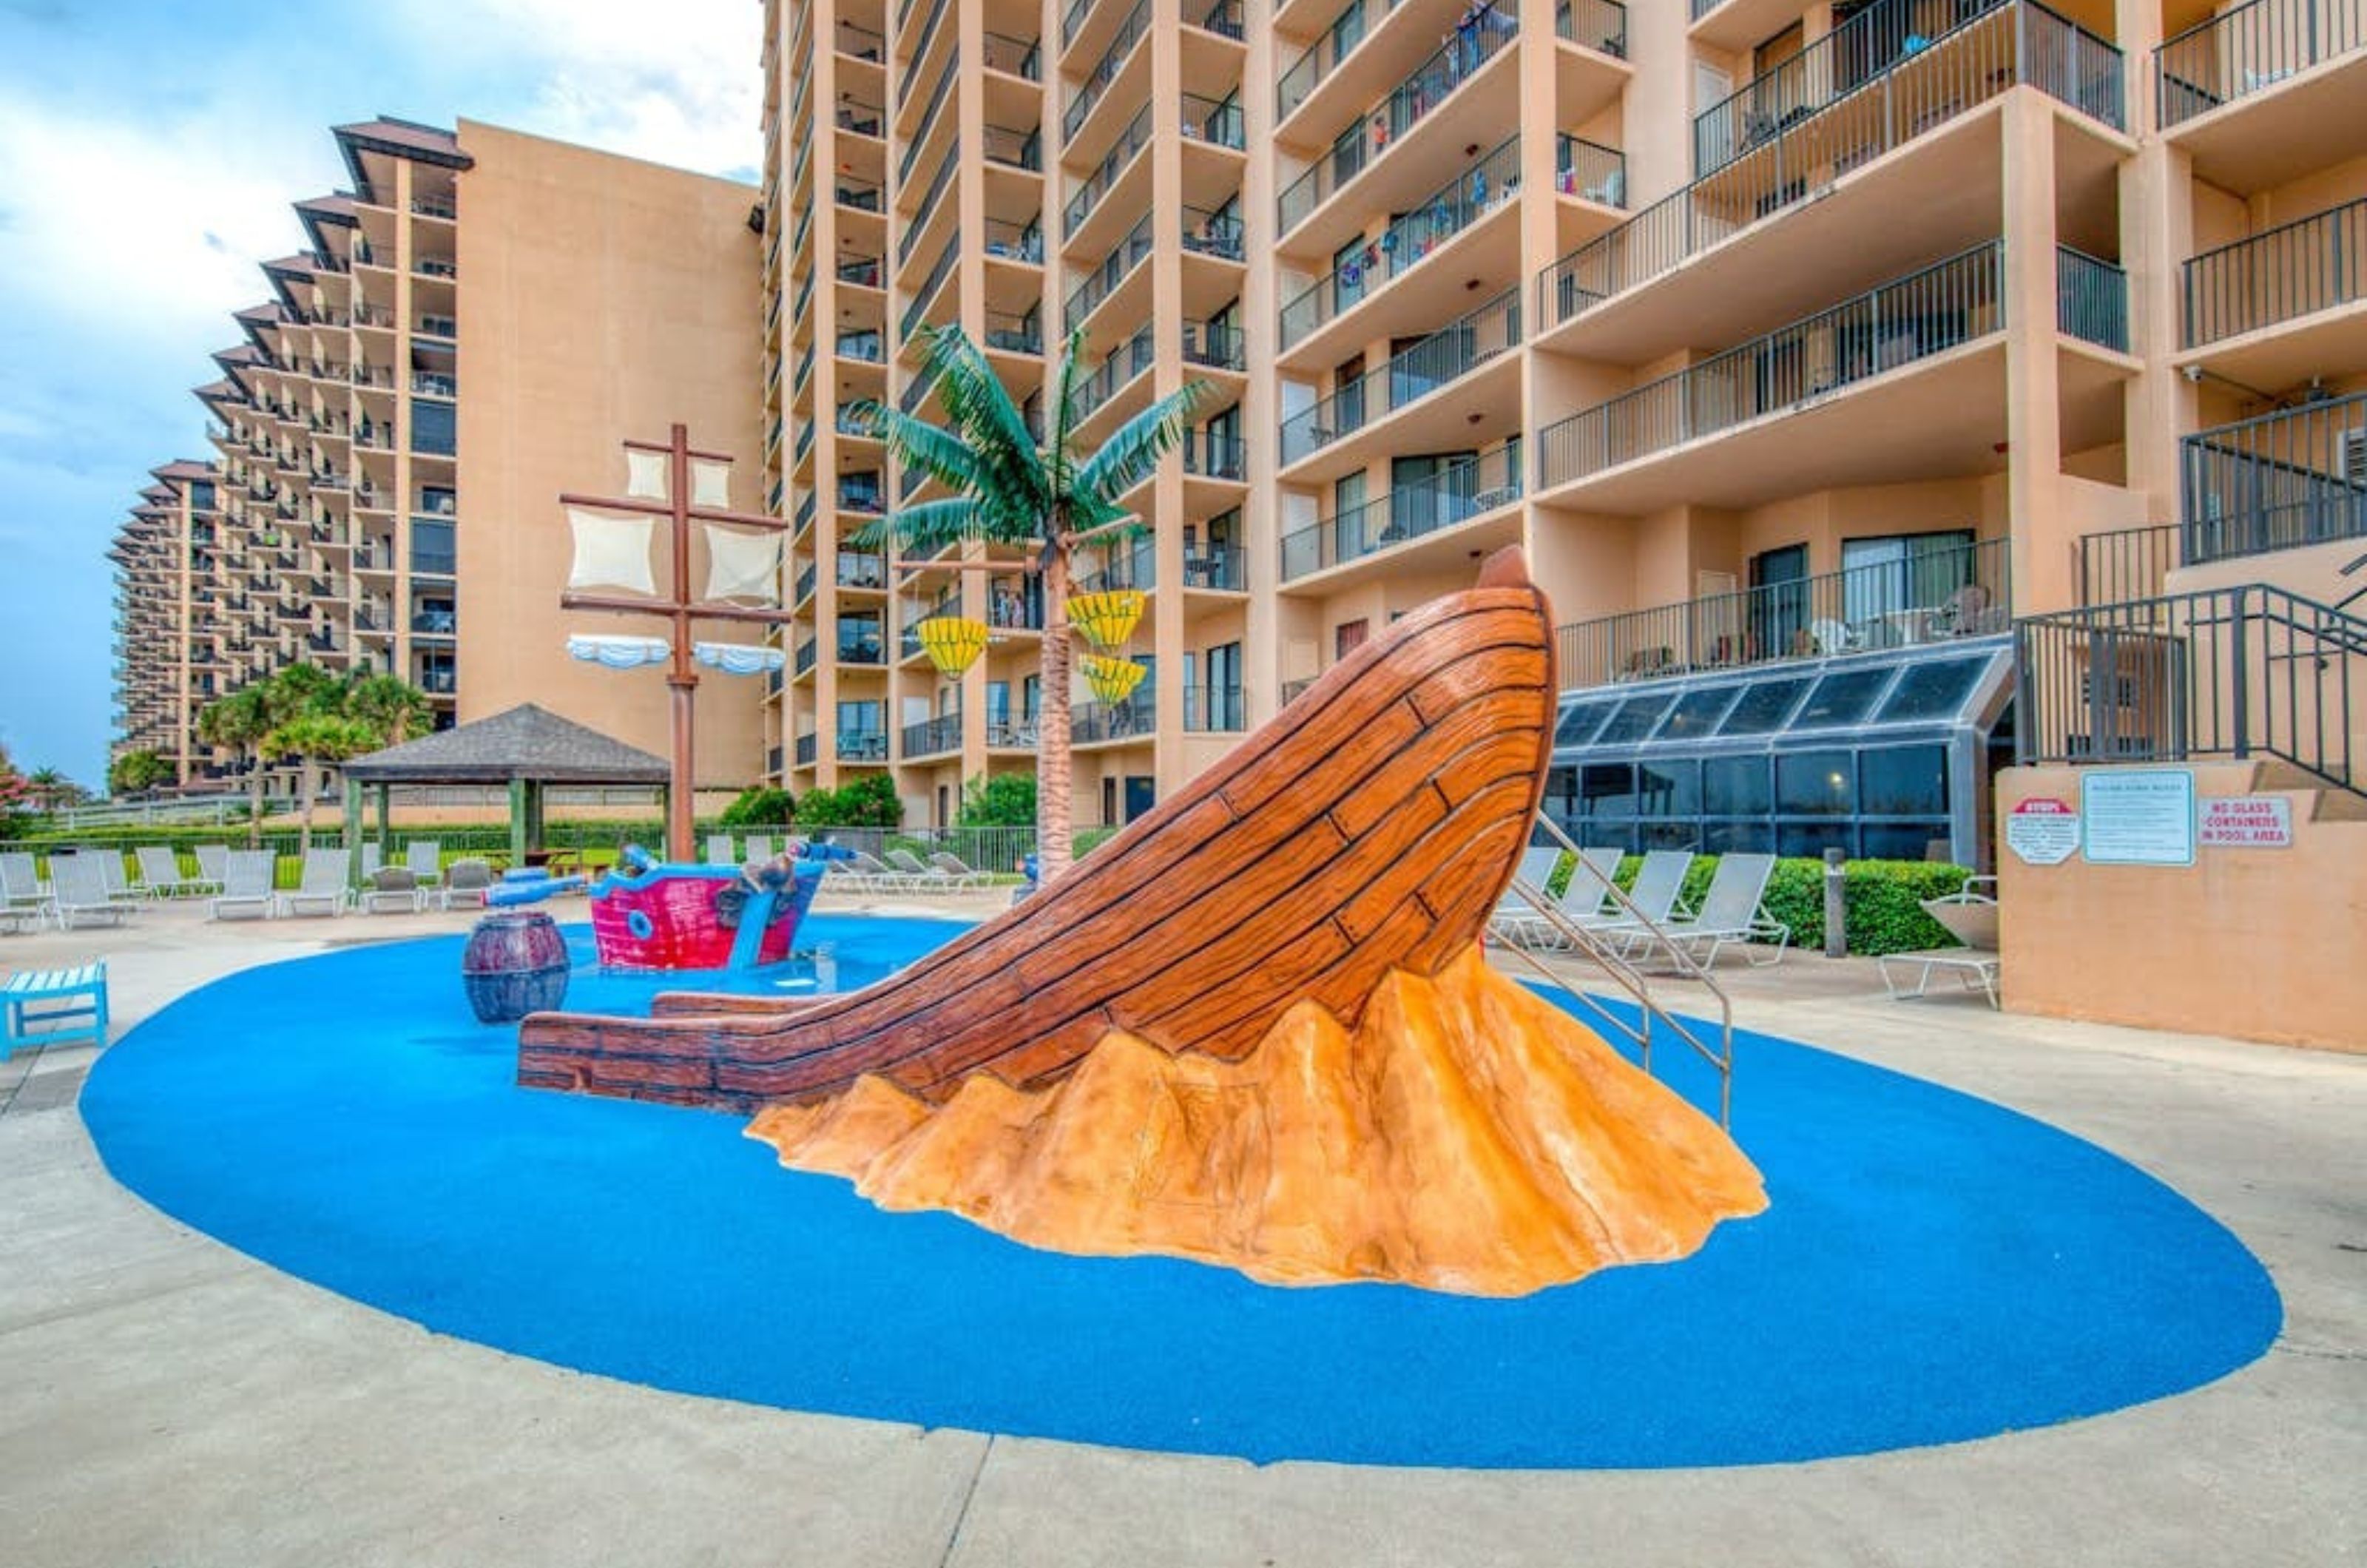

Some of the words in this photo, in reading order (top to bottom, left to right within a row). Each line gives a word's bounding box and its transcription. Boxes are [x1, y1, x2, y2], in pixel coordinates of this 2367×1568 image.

[2212, 802, 2229, 814] NO
[2232, 802, 2271, 814] GLASS
[2206, 816, 2279, 828] CONTAINERS
[2201, 830, 2214, 841] IN
[2217, 830, 2247, 841] POOL
[2253, 830, 2285, 842] AREA
